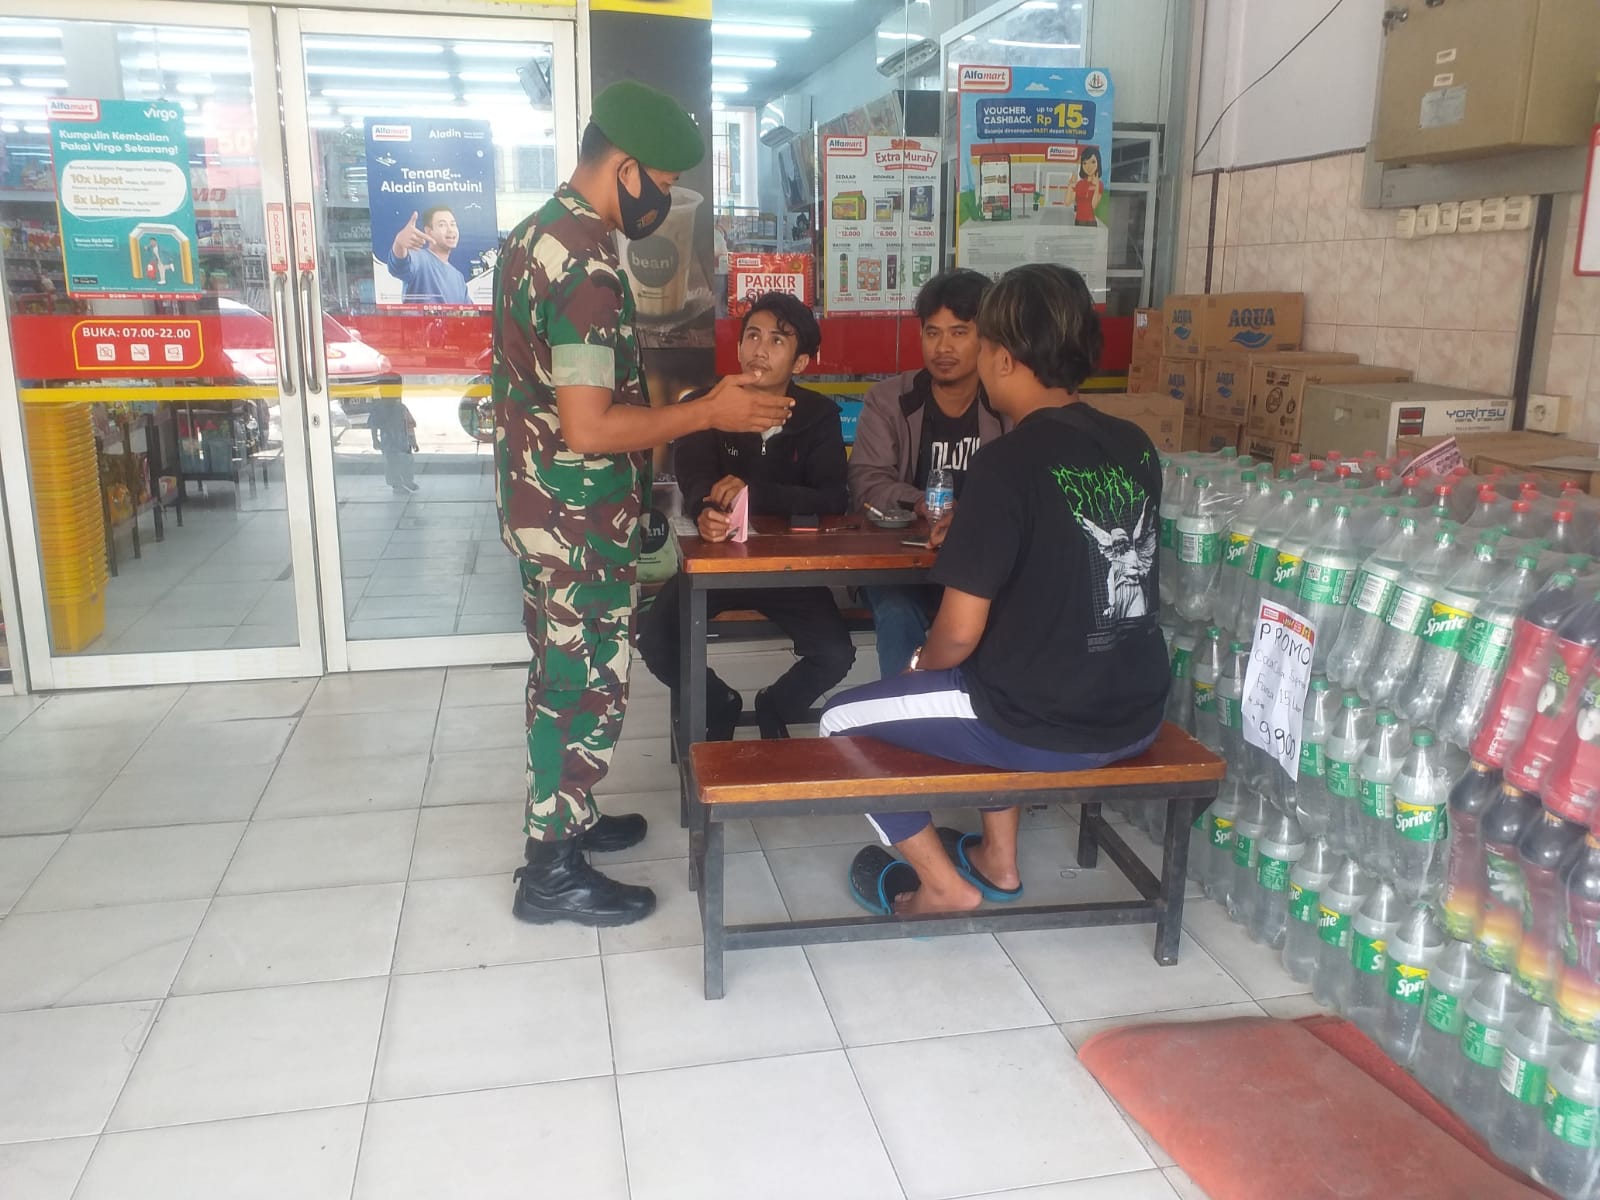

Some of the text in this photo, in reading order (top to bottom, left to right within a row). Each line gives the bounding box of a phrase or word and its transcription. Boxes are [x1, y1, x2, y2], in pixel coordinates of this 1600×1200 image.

[964, 70, 1006, 80] Alfamart
[50, 101, 93, 111] Alfamart
[984, 106, 1026, 115] VOUCHER
[984, 115, 1032, 125] CASHBACK
[1036, 114, 1052, 126] Rp
[1054, 103, 1084, 129] 15
[59, 130, 169, 143] Kumpulin Kembalian
[375, 127, 409, 135] Alfamart
[429, 127, 462, 139] Aladin
[61, 142, 178, 156] Pakai Virgo Sekarang!
[829, 139, 862, 148] Alfamart
[875, 151, 932, 163] Extra Murah
[70, 174, 91, 184] 10x
[94, 174, 123, 186] Lipat
[401, 168, 461, 180] Tenang...
[381, 180, 483, 193] Aladin Bantuin!
[73, 194, 87, 205] 5x
[90, 195, 119, 207] Lipat
[301, 212, 309, 253] TARIK
[745, 275, 796, 288] PARKIR
[1172, 309, 1193, 325] AQUA
[1227, 307, 1276, 330] AQUA
[82, 327, 191, 339] BUKA: 07.00-22.00
[1446, 407, 1507, 420] YORITSU
[1424, 613, 1468, 636] Sprite
[1395, 810, 1433, 831] Sprite
